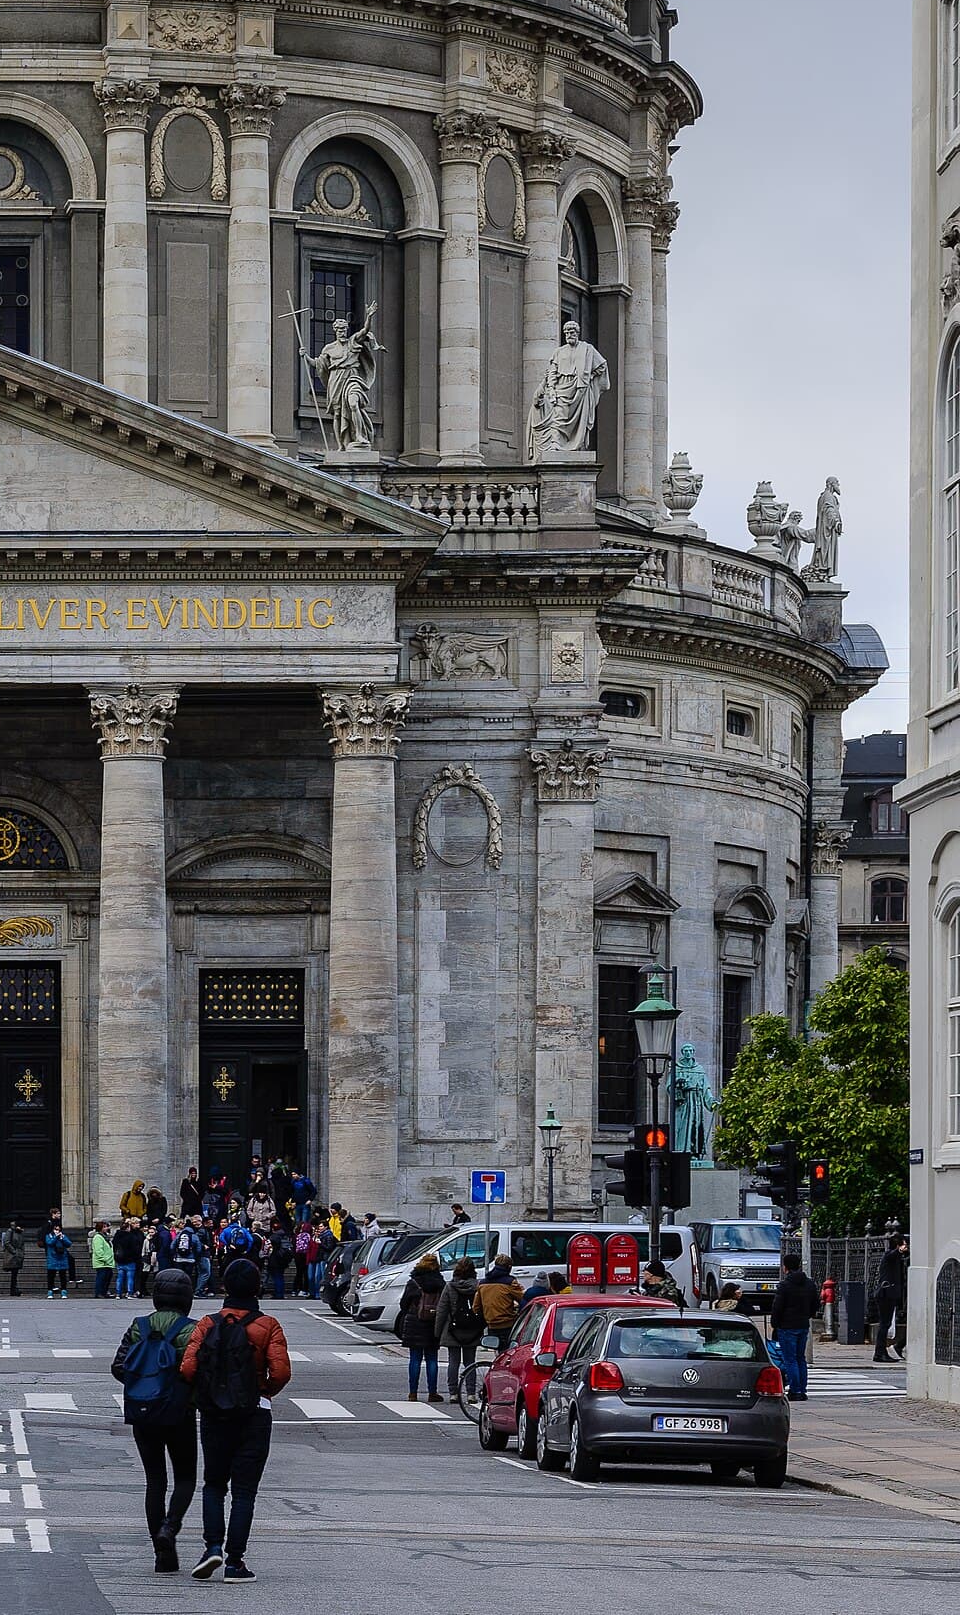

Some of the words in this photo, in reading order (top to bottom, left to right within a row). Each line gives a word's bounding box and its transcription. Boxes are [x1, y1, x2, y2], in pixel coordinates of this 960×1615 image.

[126, 597, 335, 630] EVINDELIG
[665, 1418, 680, 1428] GF
[682, 1418, 697, 1429] 26
[699, 1419, 720, 1430] 998
